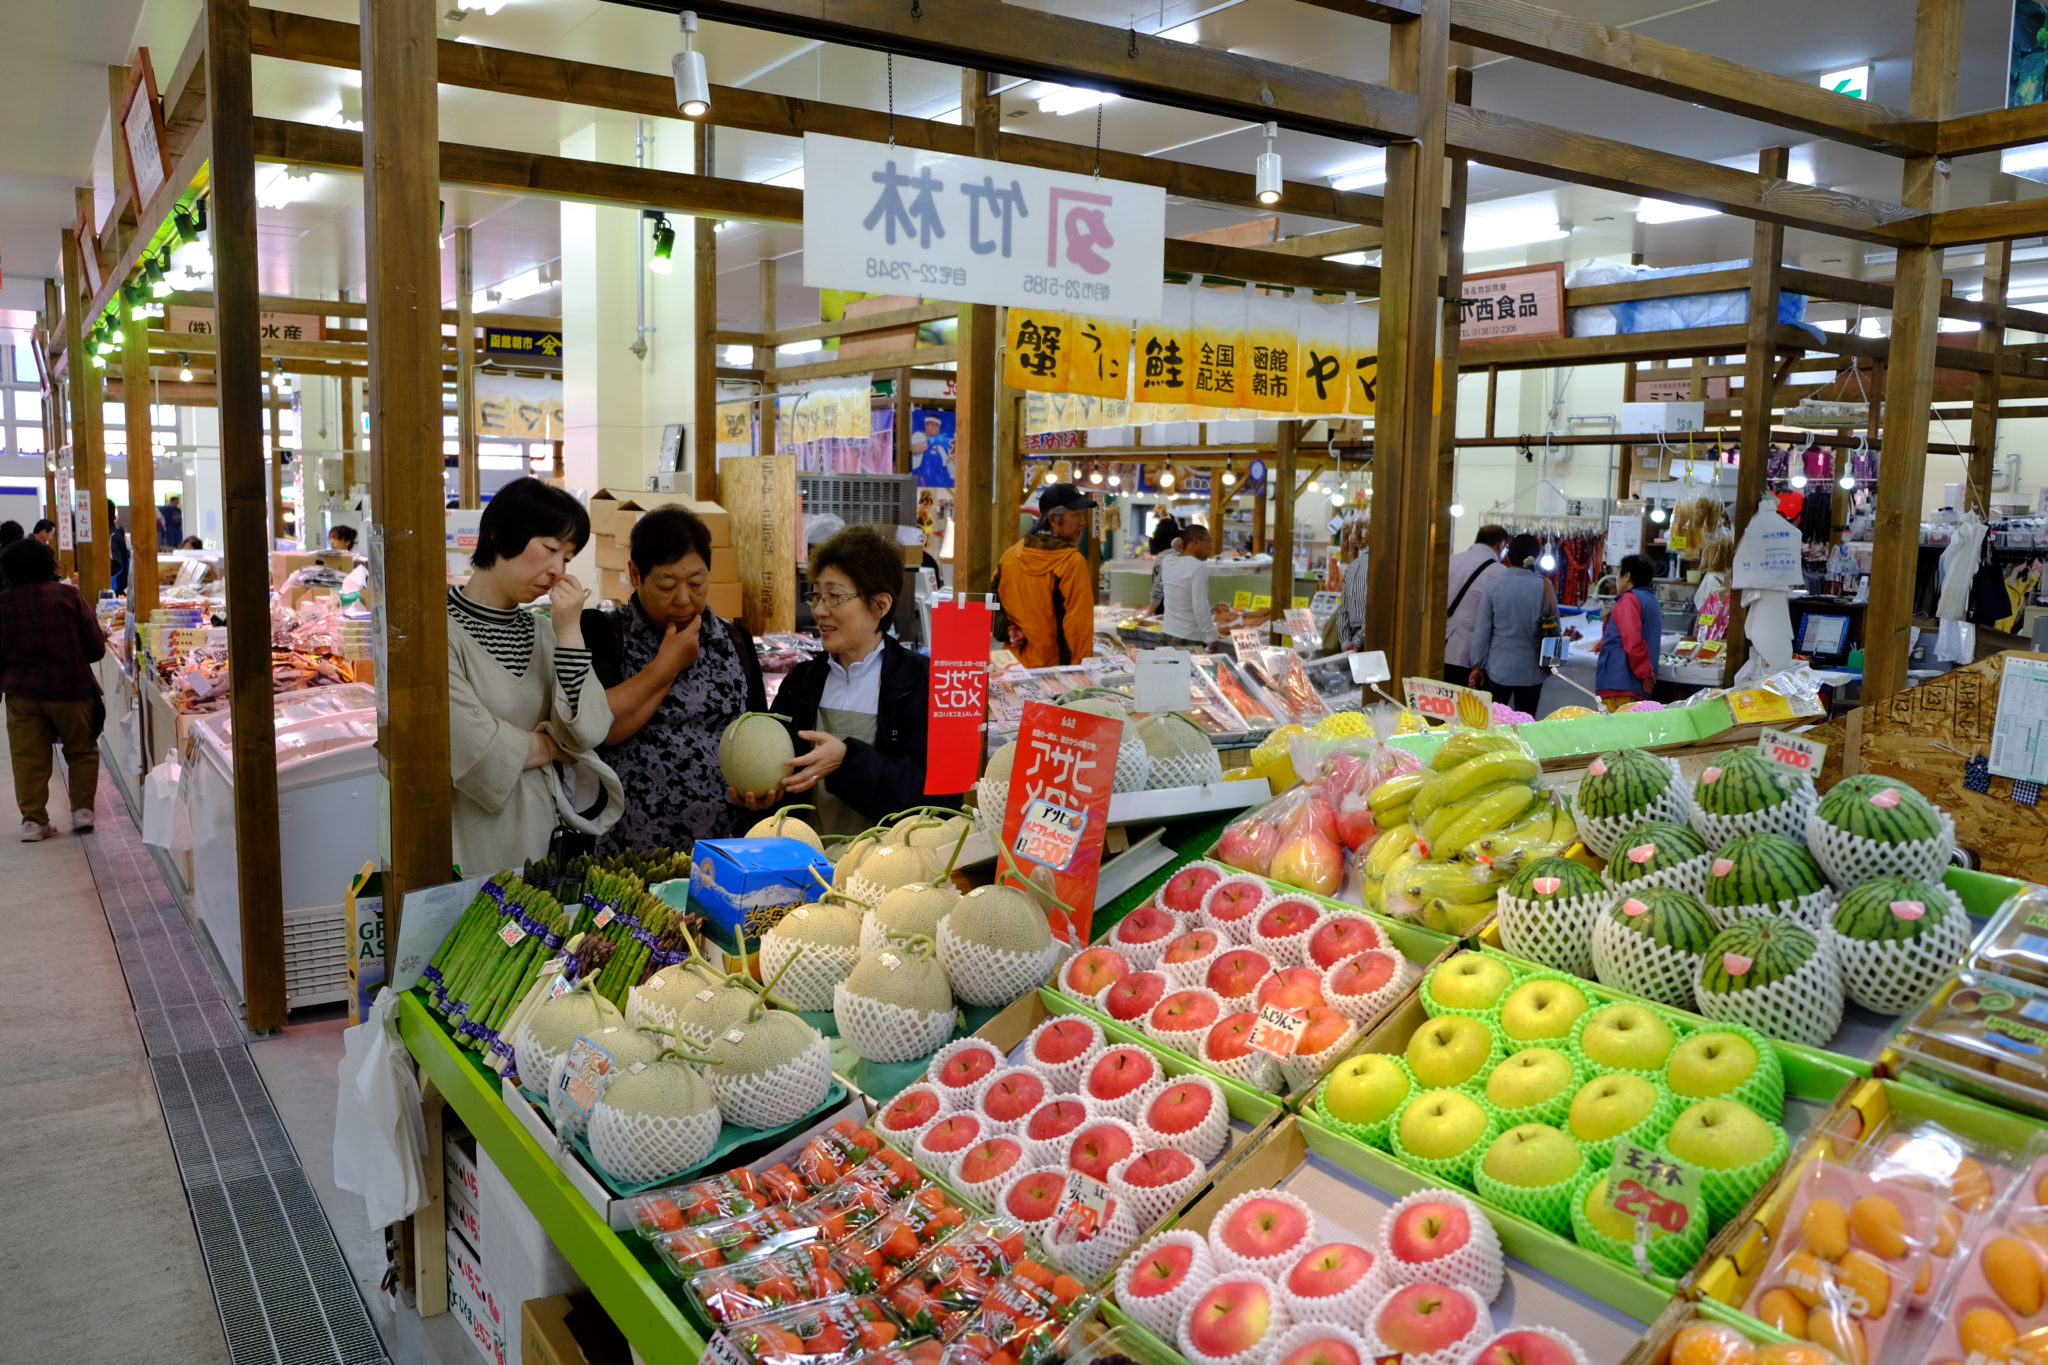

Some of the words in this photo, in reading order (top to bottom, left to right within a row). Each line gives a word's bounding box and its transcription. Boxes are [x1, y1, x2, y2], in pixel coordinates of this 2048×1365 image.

[1081, 323, 1119, 381] うに
[1143, 336, 1184, 388] 鮭
[1200, 342, 1235, 367] 全国
[1253, 346, 1289, 373] 函館
[1196, 367, 1235, 393] 配送
[1252, 371, 1289, 398] 朝市
[1418, 694, 1456, 717] 200
[1026, 740, 1097, 794] アサヒ
[1772, 745, 1811, 768] 700
[1042, 805, 1069, 826] アサヒ
[1255, 1024, 1296, 1057] 300
